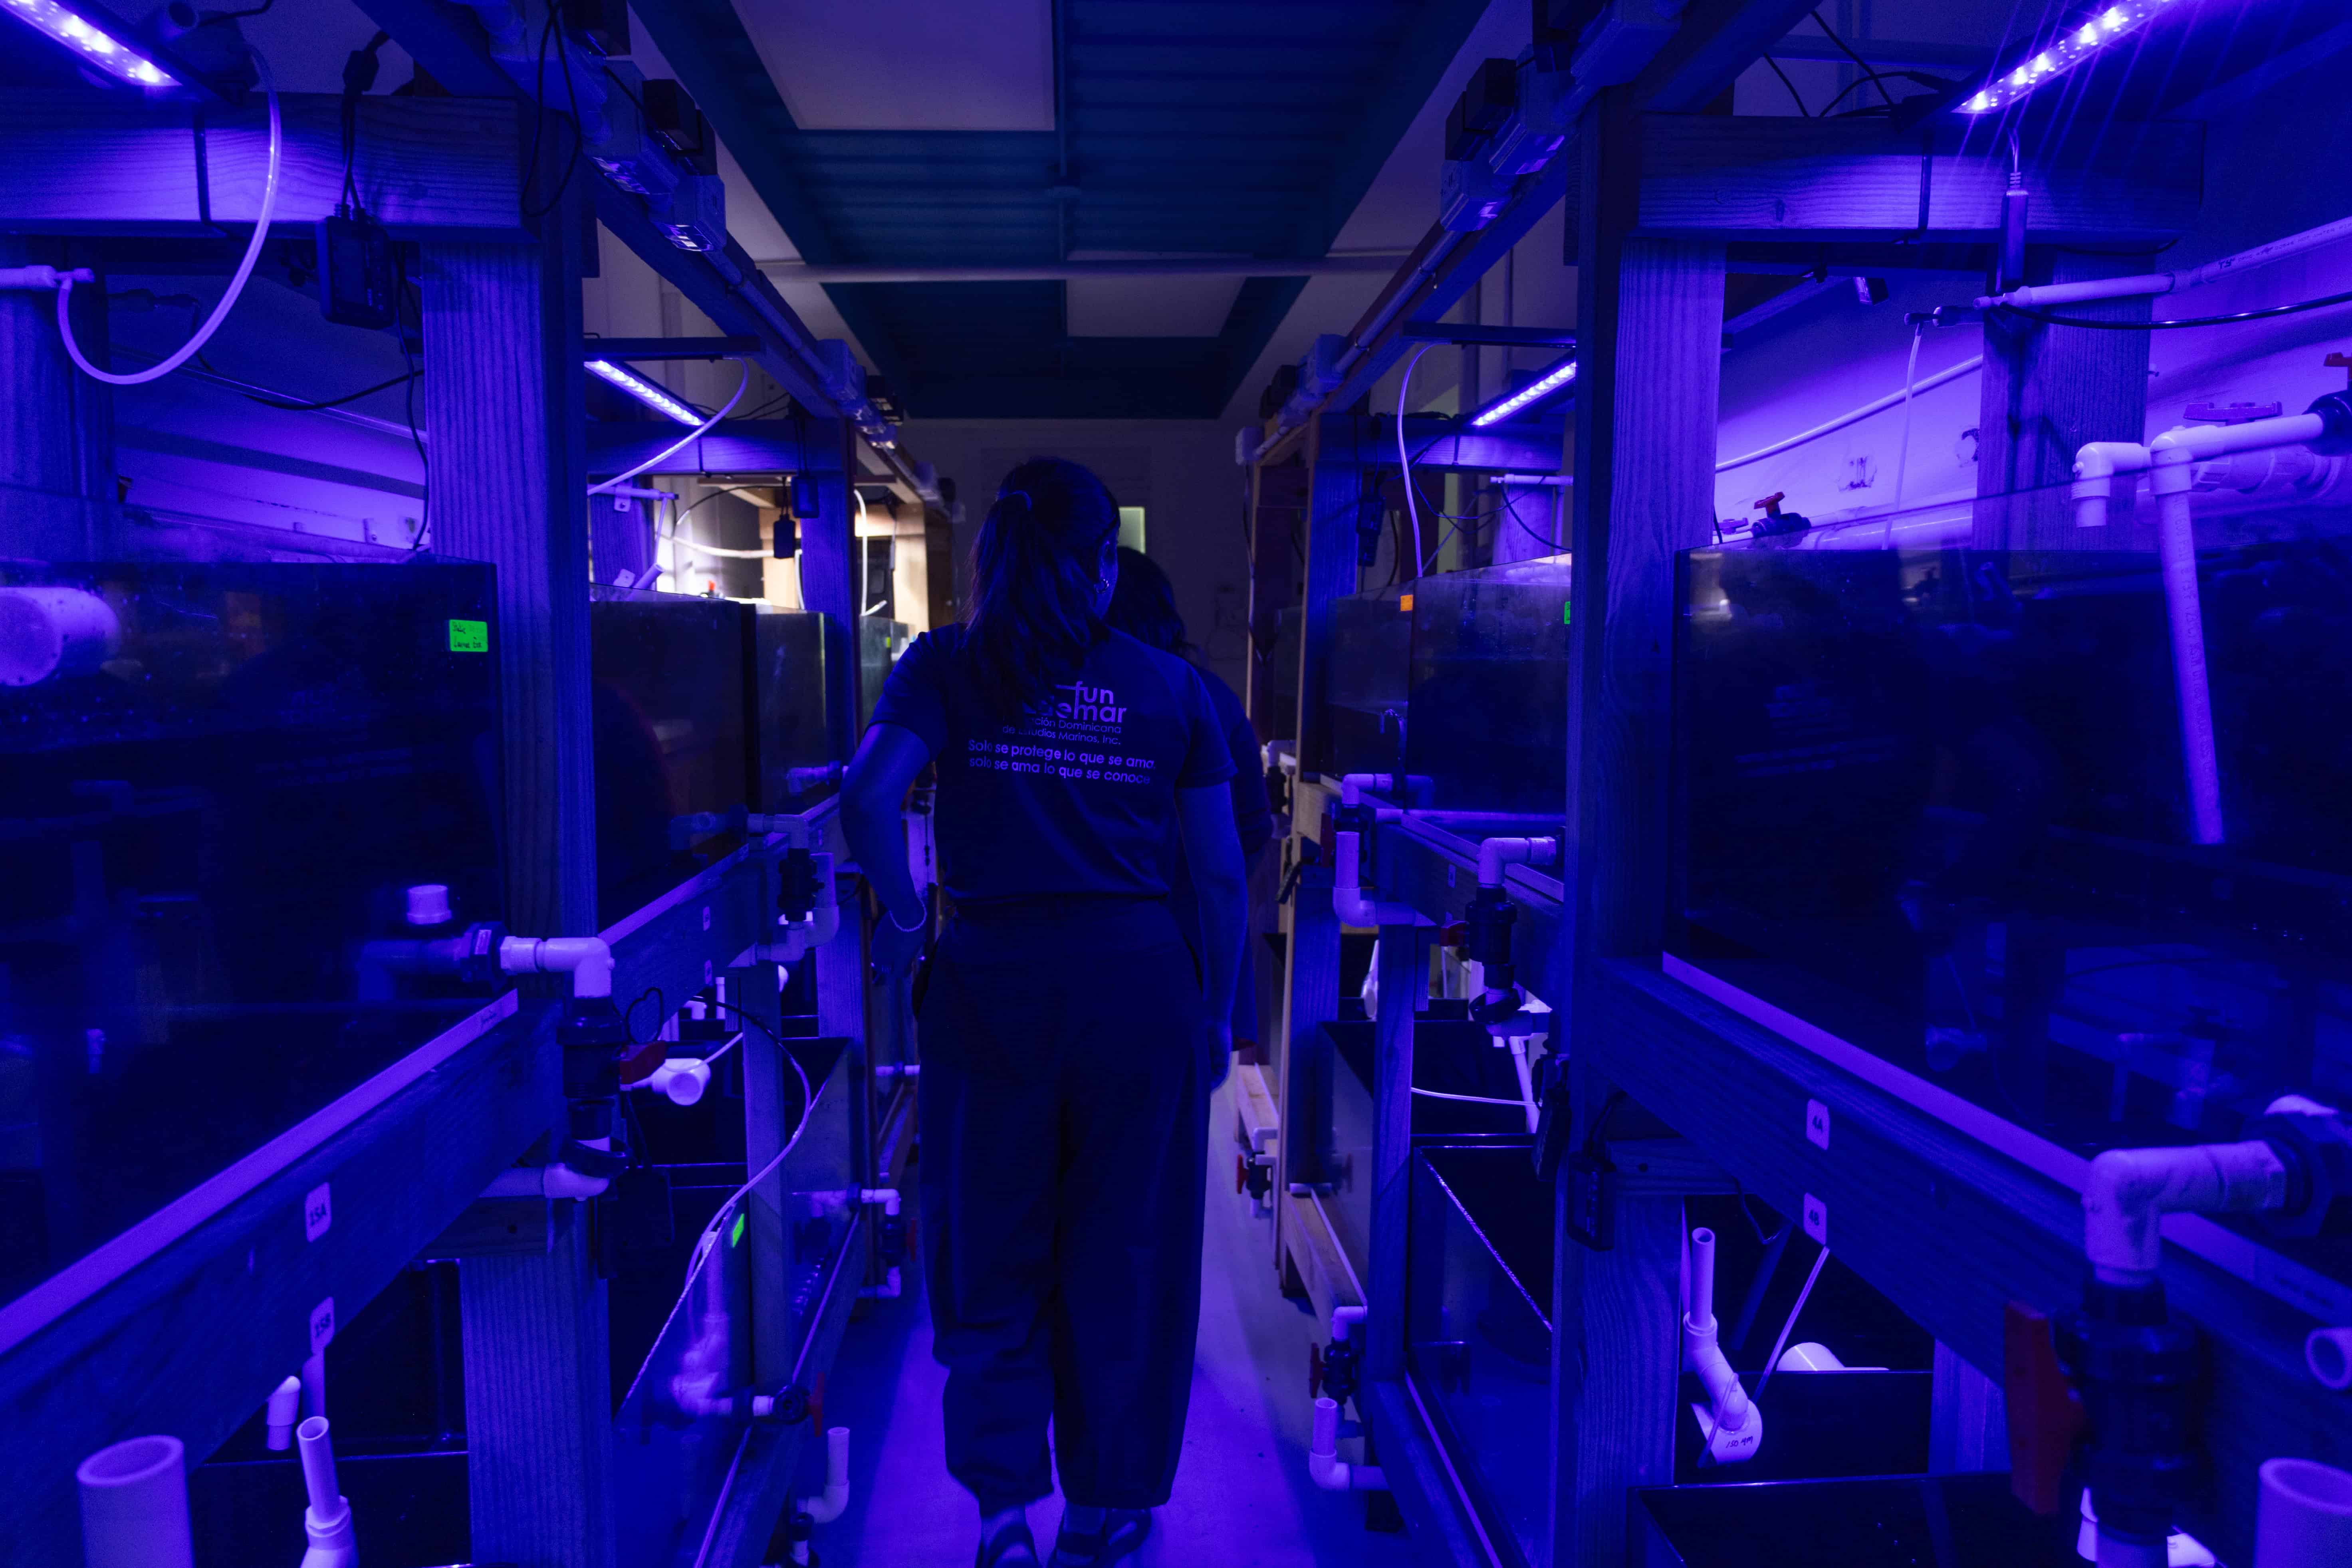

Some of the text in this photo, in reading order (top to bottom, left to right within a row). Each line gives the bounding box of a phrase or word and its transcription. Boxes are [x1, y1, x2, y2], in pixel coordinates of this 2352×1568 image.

[1055, 680, 1114, 705] fun
[1003, 725, 1015, 734] de
[1058, 731, 1100, 743] Marinos,
[1103, 735, 1121, 745] Inc.
[1059, 720, 1122, 734] Dominicana
[968, 739, 992, 752] Solo
[995, 743, 1009, 754] se
[1011, 745, 1061, 761] protege
[1063, 749, 1076, 761] lo
[1079, 753, 1105, 765] que
[1108, 755, 1122, 766] se
[969, 755, 1151, 785] solo se ama lo que se conoce
[1812, 1115, 1823, 1133] 4A
[310, 1203, 326, 1226] 15A
[1808, 1209, 1820, 1226] 4B
[1725, 1440, 1739, 1448] 150
